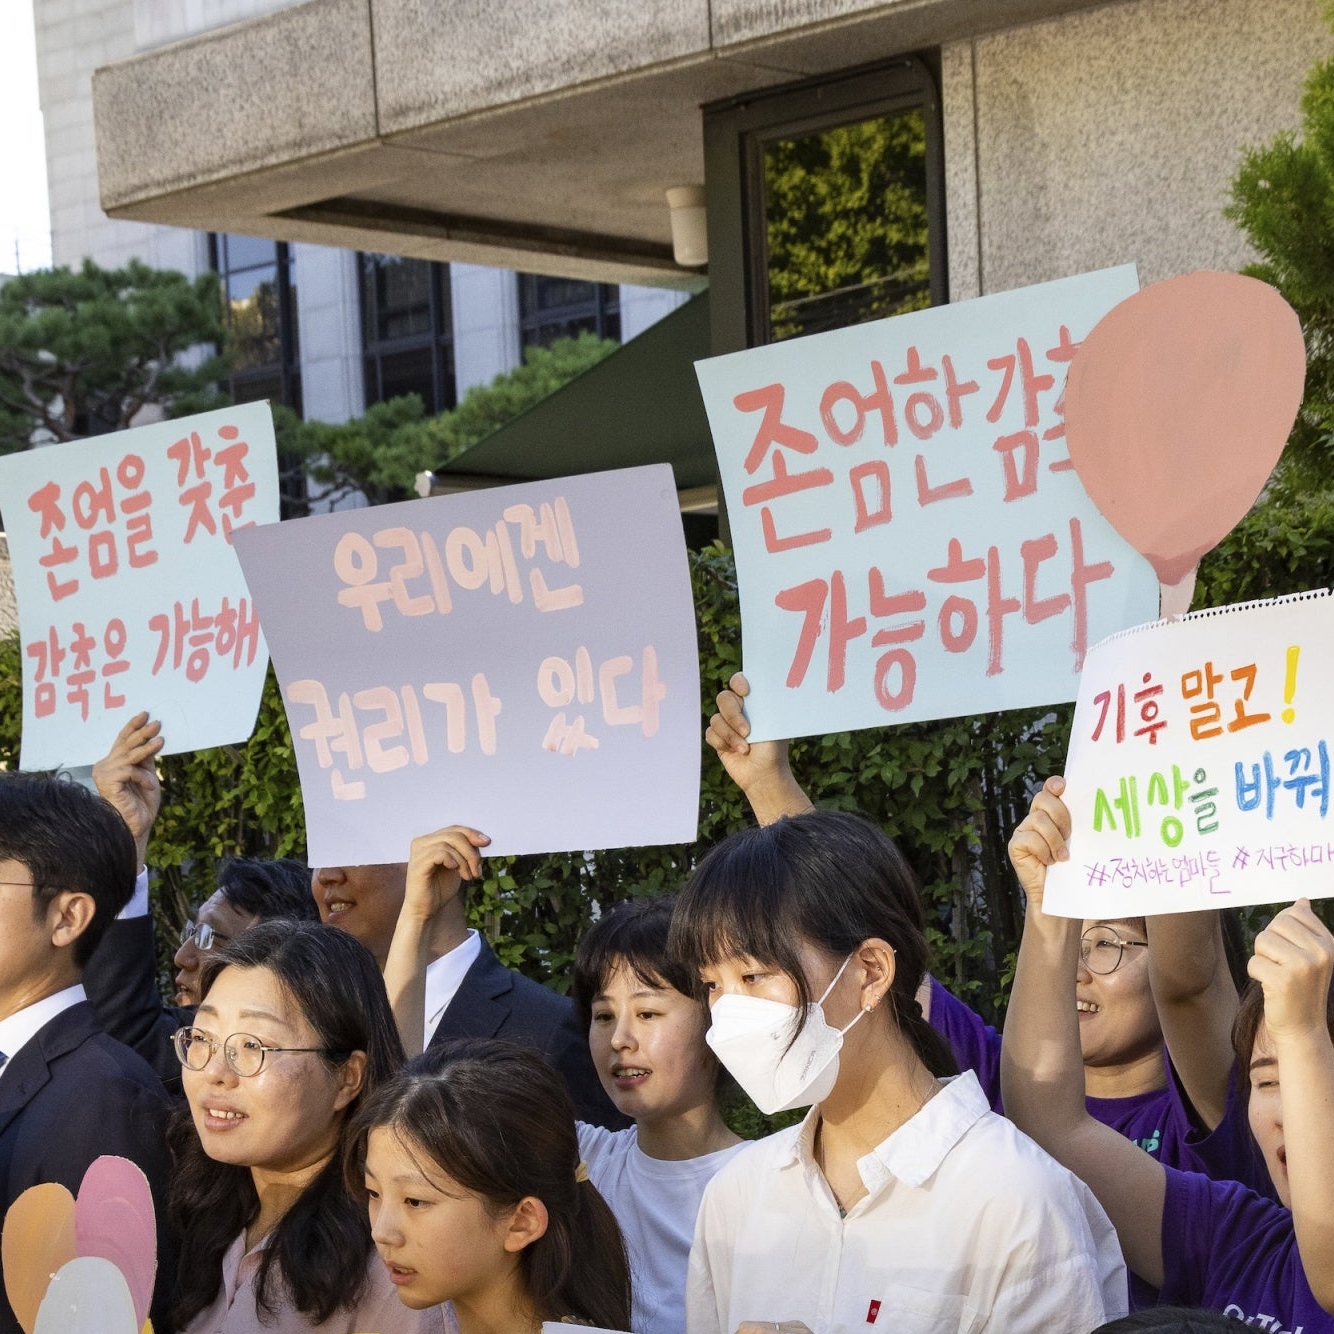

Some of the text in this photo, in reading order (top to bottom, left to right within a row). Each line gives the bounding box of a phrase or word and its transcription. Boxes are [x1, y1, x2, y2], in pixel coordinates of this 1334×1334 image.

[28, 425, 256, 602] 존엄을 갖춘
[733, 346, 979, 553] 존엄한
[334, 495, 584, 633] 우리에겐
[775, 517, 1115, 712] 가능하다
[26, 596, 260, 723] 감축은 가능해
[287, 643, 666, 801] 권리가 있다
[1091, 672, 1167, 745] 기후
[1093, 764, 1219, 848] 세상을
